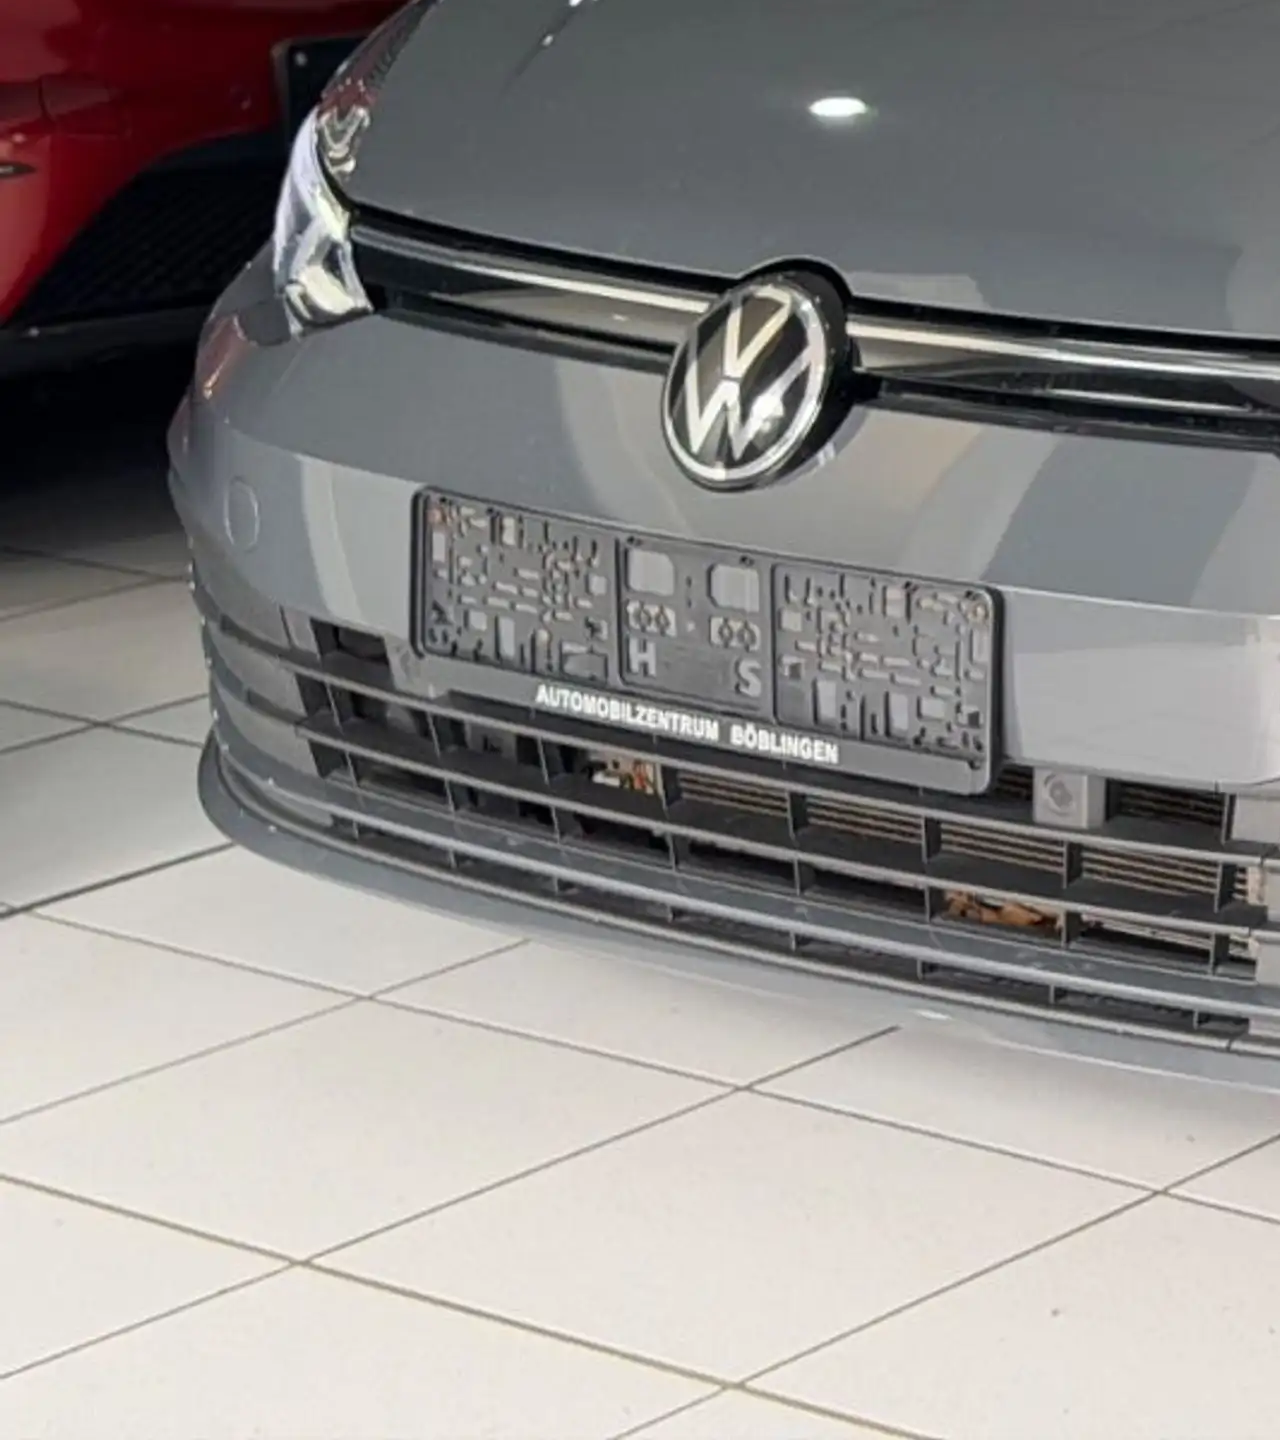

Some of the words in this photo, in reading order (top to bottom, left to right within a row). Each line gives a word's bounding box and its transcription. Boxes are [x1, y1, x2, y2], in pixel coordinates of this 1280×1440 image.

[628, 636, 657, 678] H
[738, 659, 763, 698] S
[535, 683, 720, 742] AUTOMOBILZENTRUM
[730, 722, 840, 765] BÖBLINGEN
